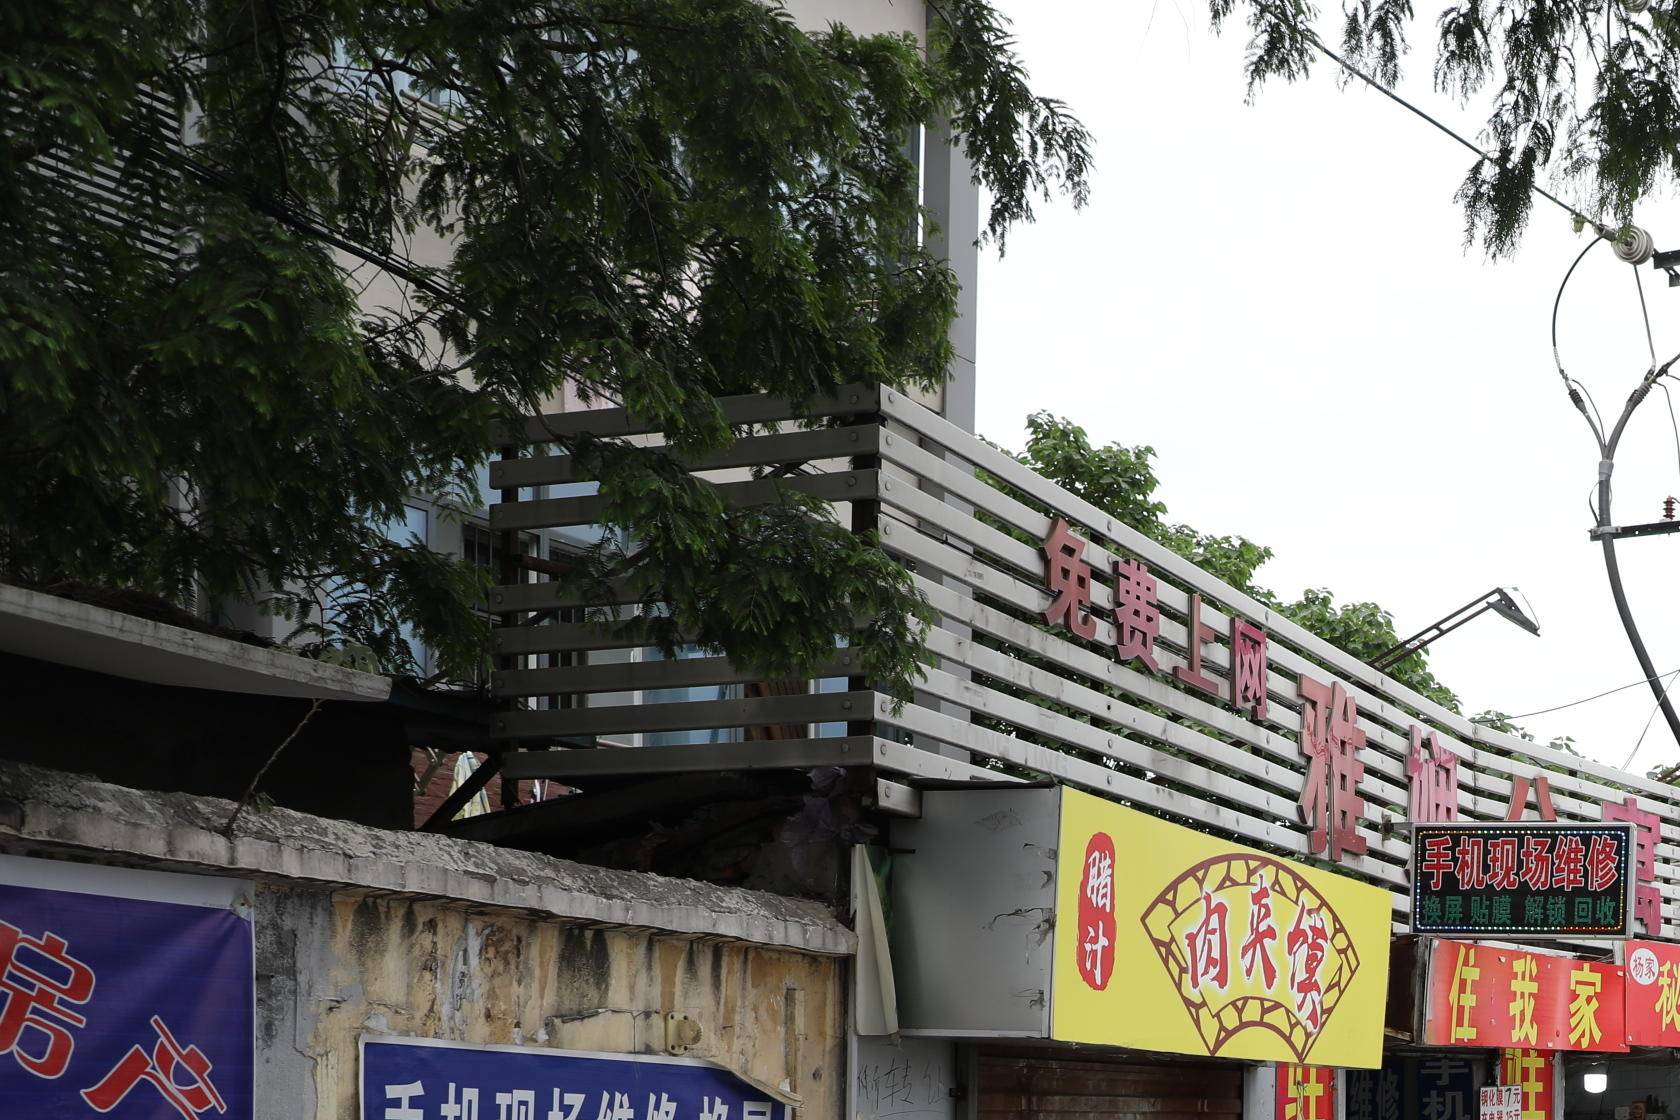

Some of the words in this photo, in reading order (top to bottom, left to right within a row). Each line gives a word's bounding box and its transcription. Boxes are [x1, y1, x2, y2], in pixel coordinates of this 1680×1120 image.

[1041, 517, 1268, 720] 免费上网
[1422, 835, 1620, 892] 手机现场维修
[1573, 896, 1616, 927] 回收
[1083, 849, 1114, 988] 腊汁
[1184, 872, 1331, 1033] 肉夹馍
[1632, 953, 1658, 981] 杨家
[1449, 943, 1604, 1048] 住我家
